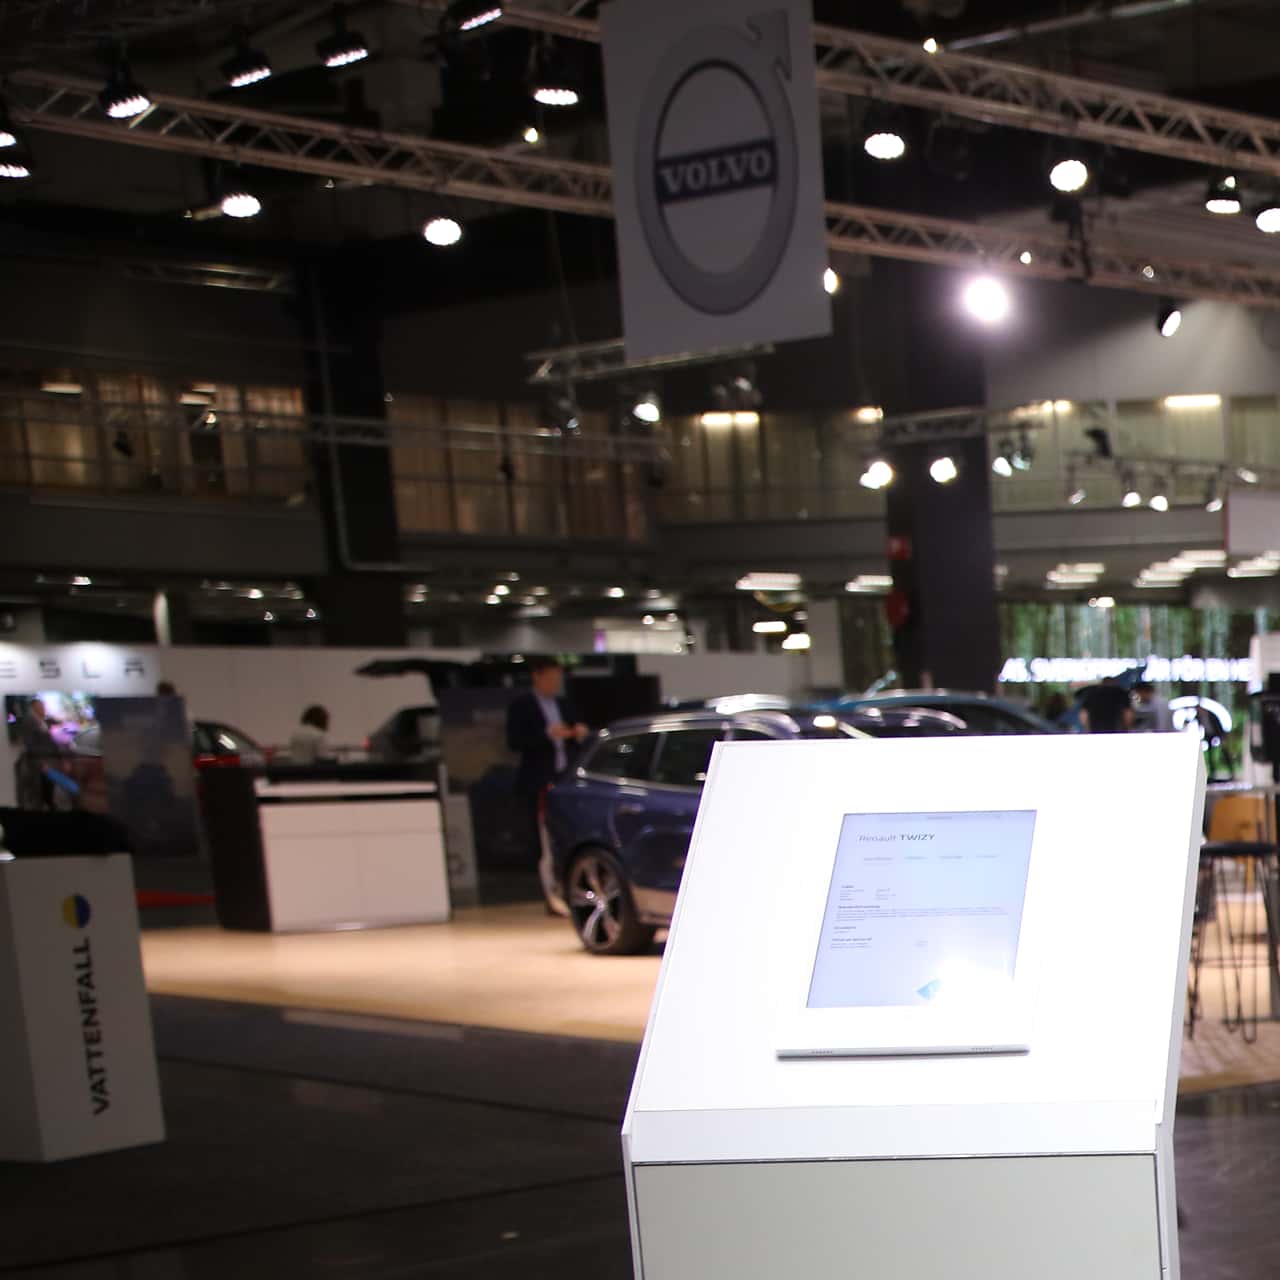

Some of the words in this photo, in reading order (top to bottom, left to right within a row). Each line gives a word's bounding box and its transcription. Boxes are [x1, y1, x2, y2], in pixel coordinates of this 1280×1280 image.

[660, 149, 771, 192] VOLVO
[900, 833, 936, 841] TWIZY
[73, 936, 110, 1117] VATTENFALL
